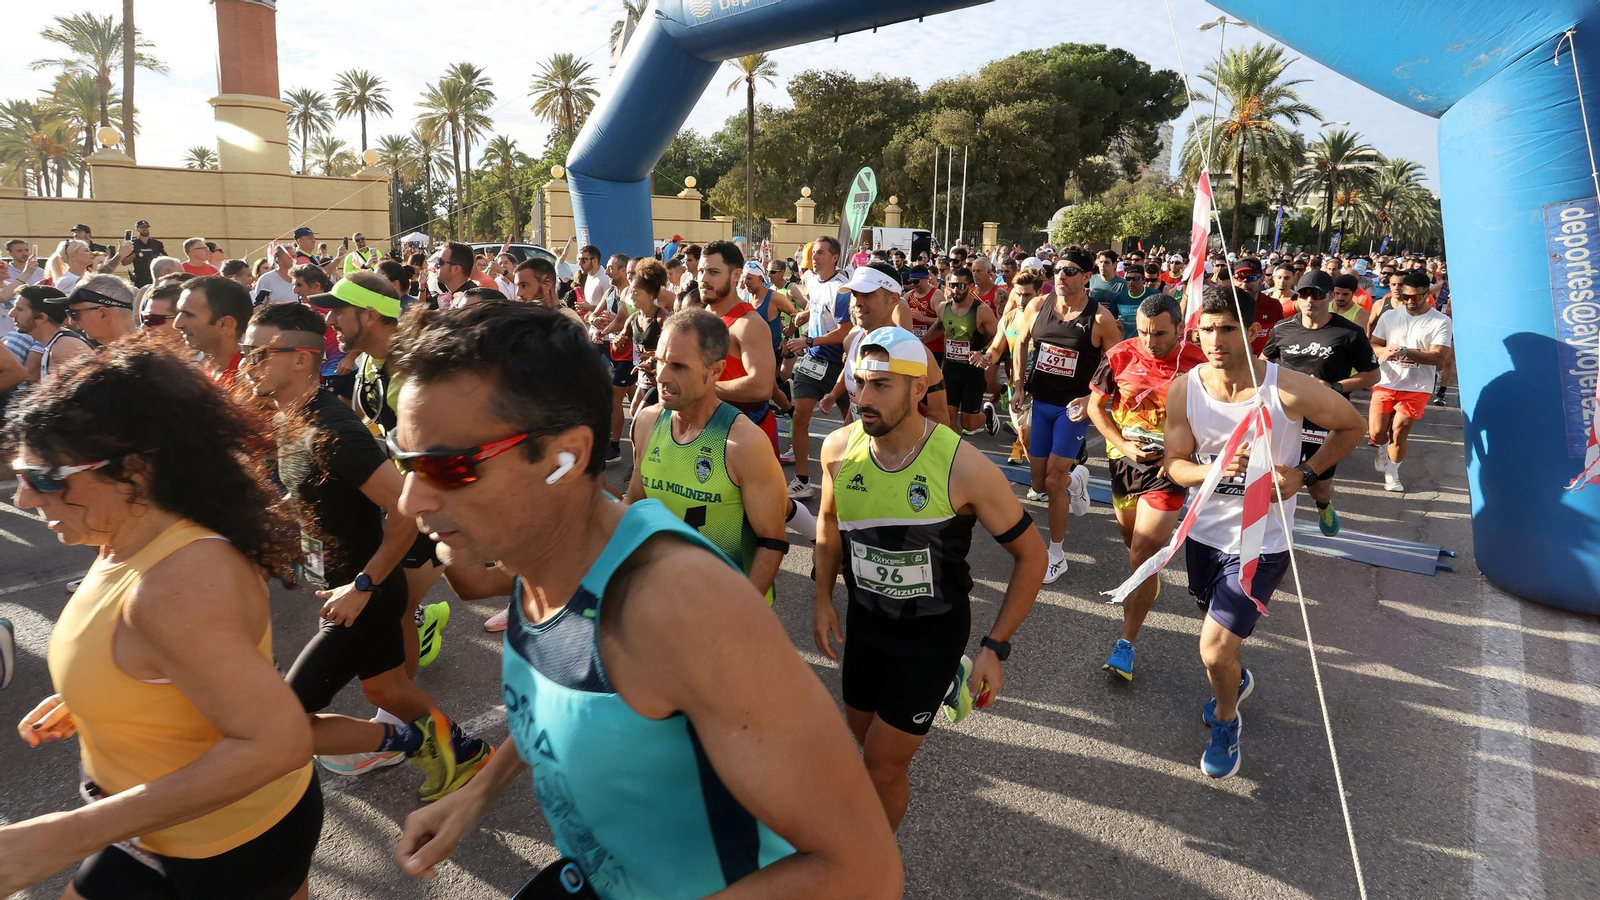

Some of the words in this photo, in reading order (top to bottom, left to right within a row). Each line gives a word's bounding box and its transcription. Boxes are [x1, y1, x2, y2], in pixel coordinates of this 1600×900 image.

[1046, 355, 1066, 367] 491
[914, 475, 927, 483] JSR
[651, 479, 663, 490] LA
[666, 481, 722, 503] MOLINERA
[876, 566, 904, 584] 96
